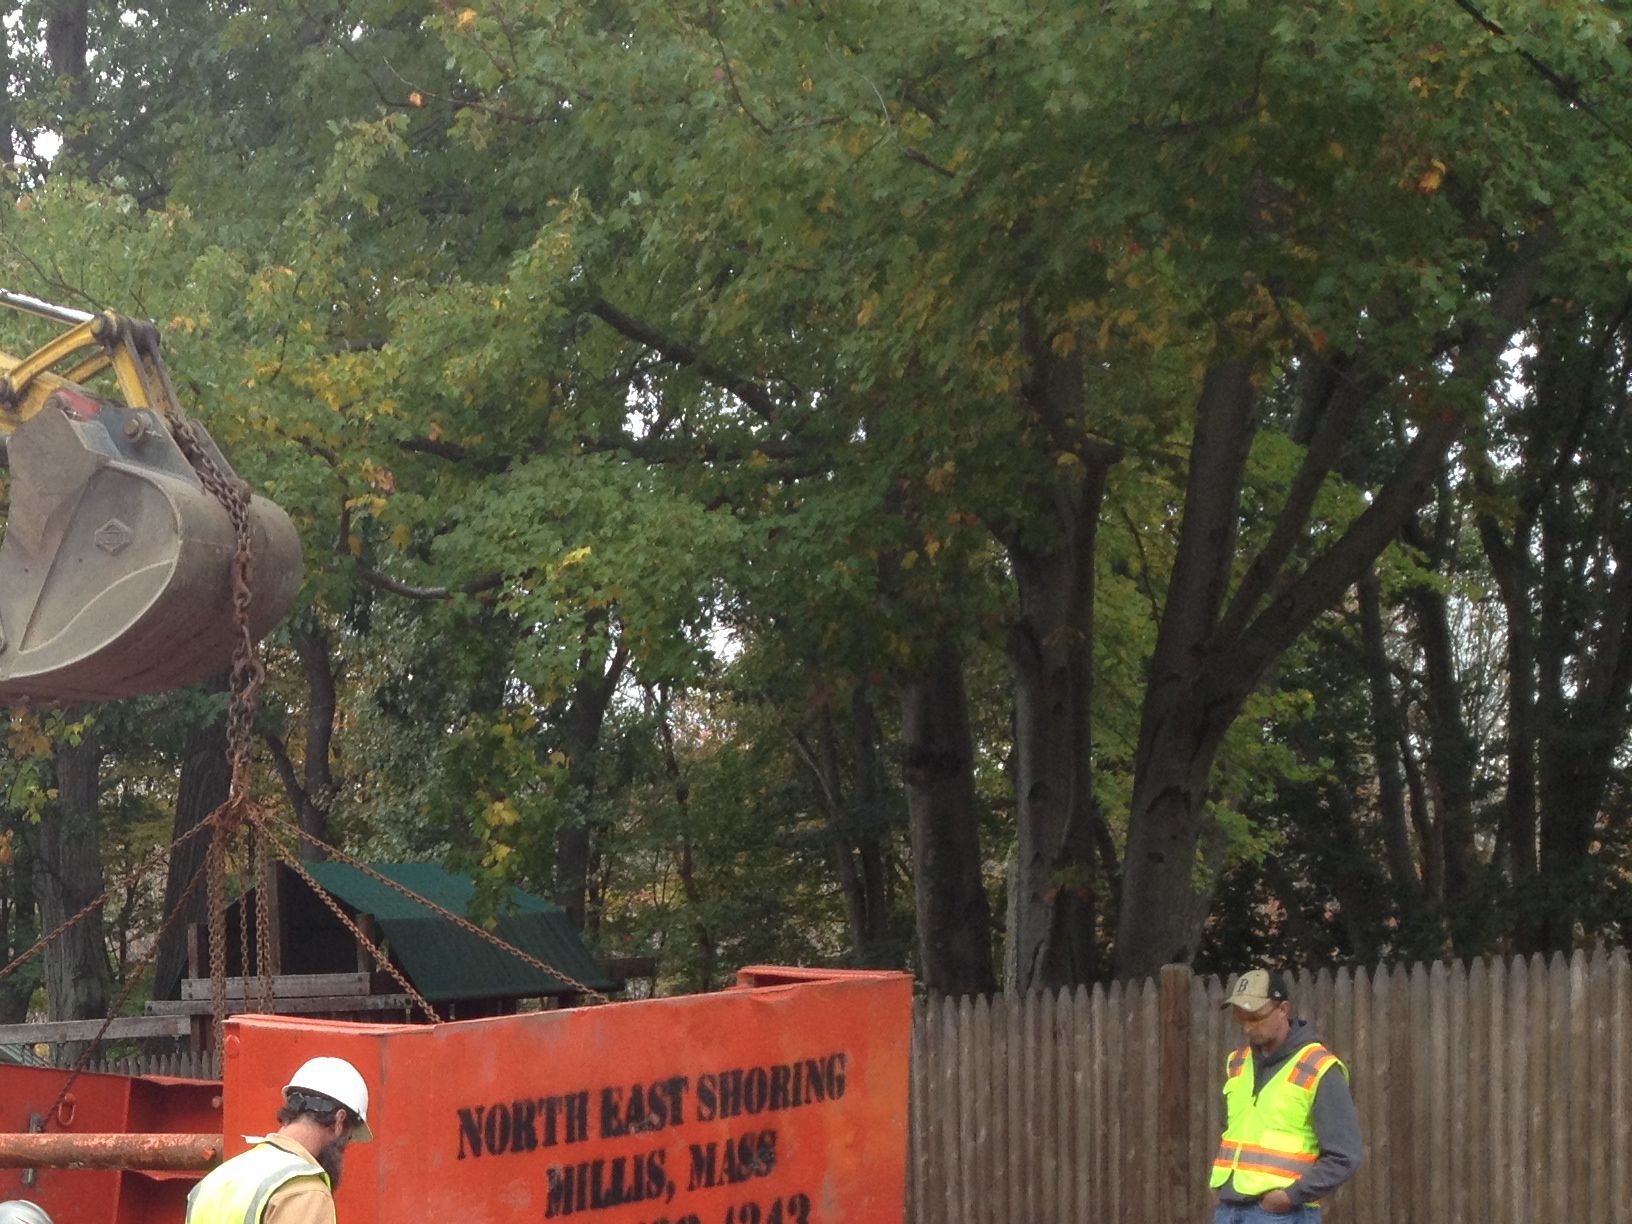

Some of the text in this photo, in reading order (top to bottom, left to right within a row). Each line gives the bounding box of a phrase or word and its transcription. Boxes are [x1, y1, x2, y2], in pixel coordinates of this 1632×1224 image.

[1237, 978, 1249, 993] B
[457, 1052, 848, 1160] NORTH EAST SHORING
[545, 1129, 778, 1219] MILLIS, MASS
